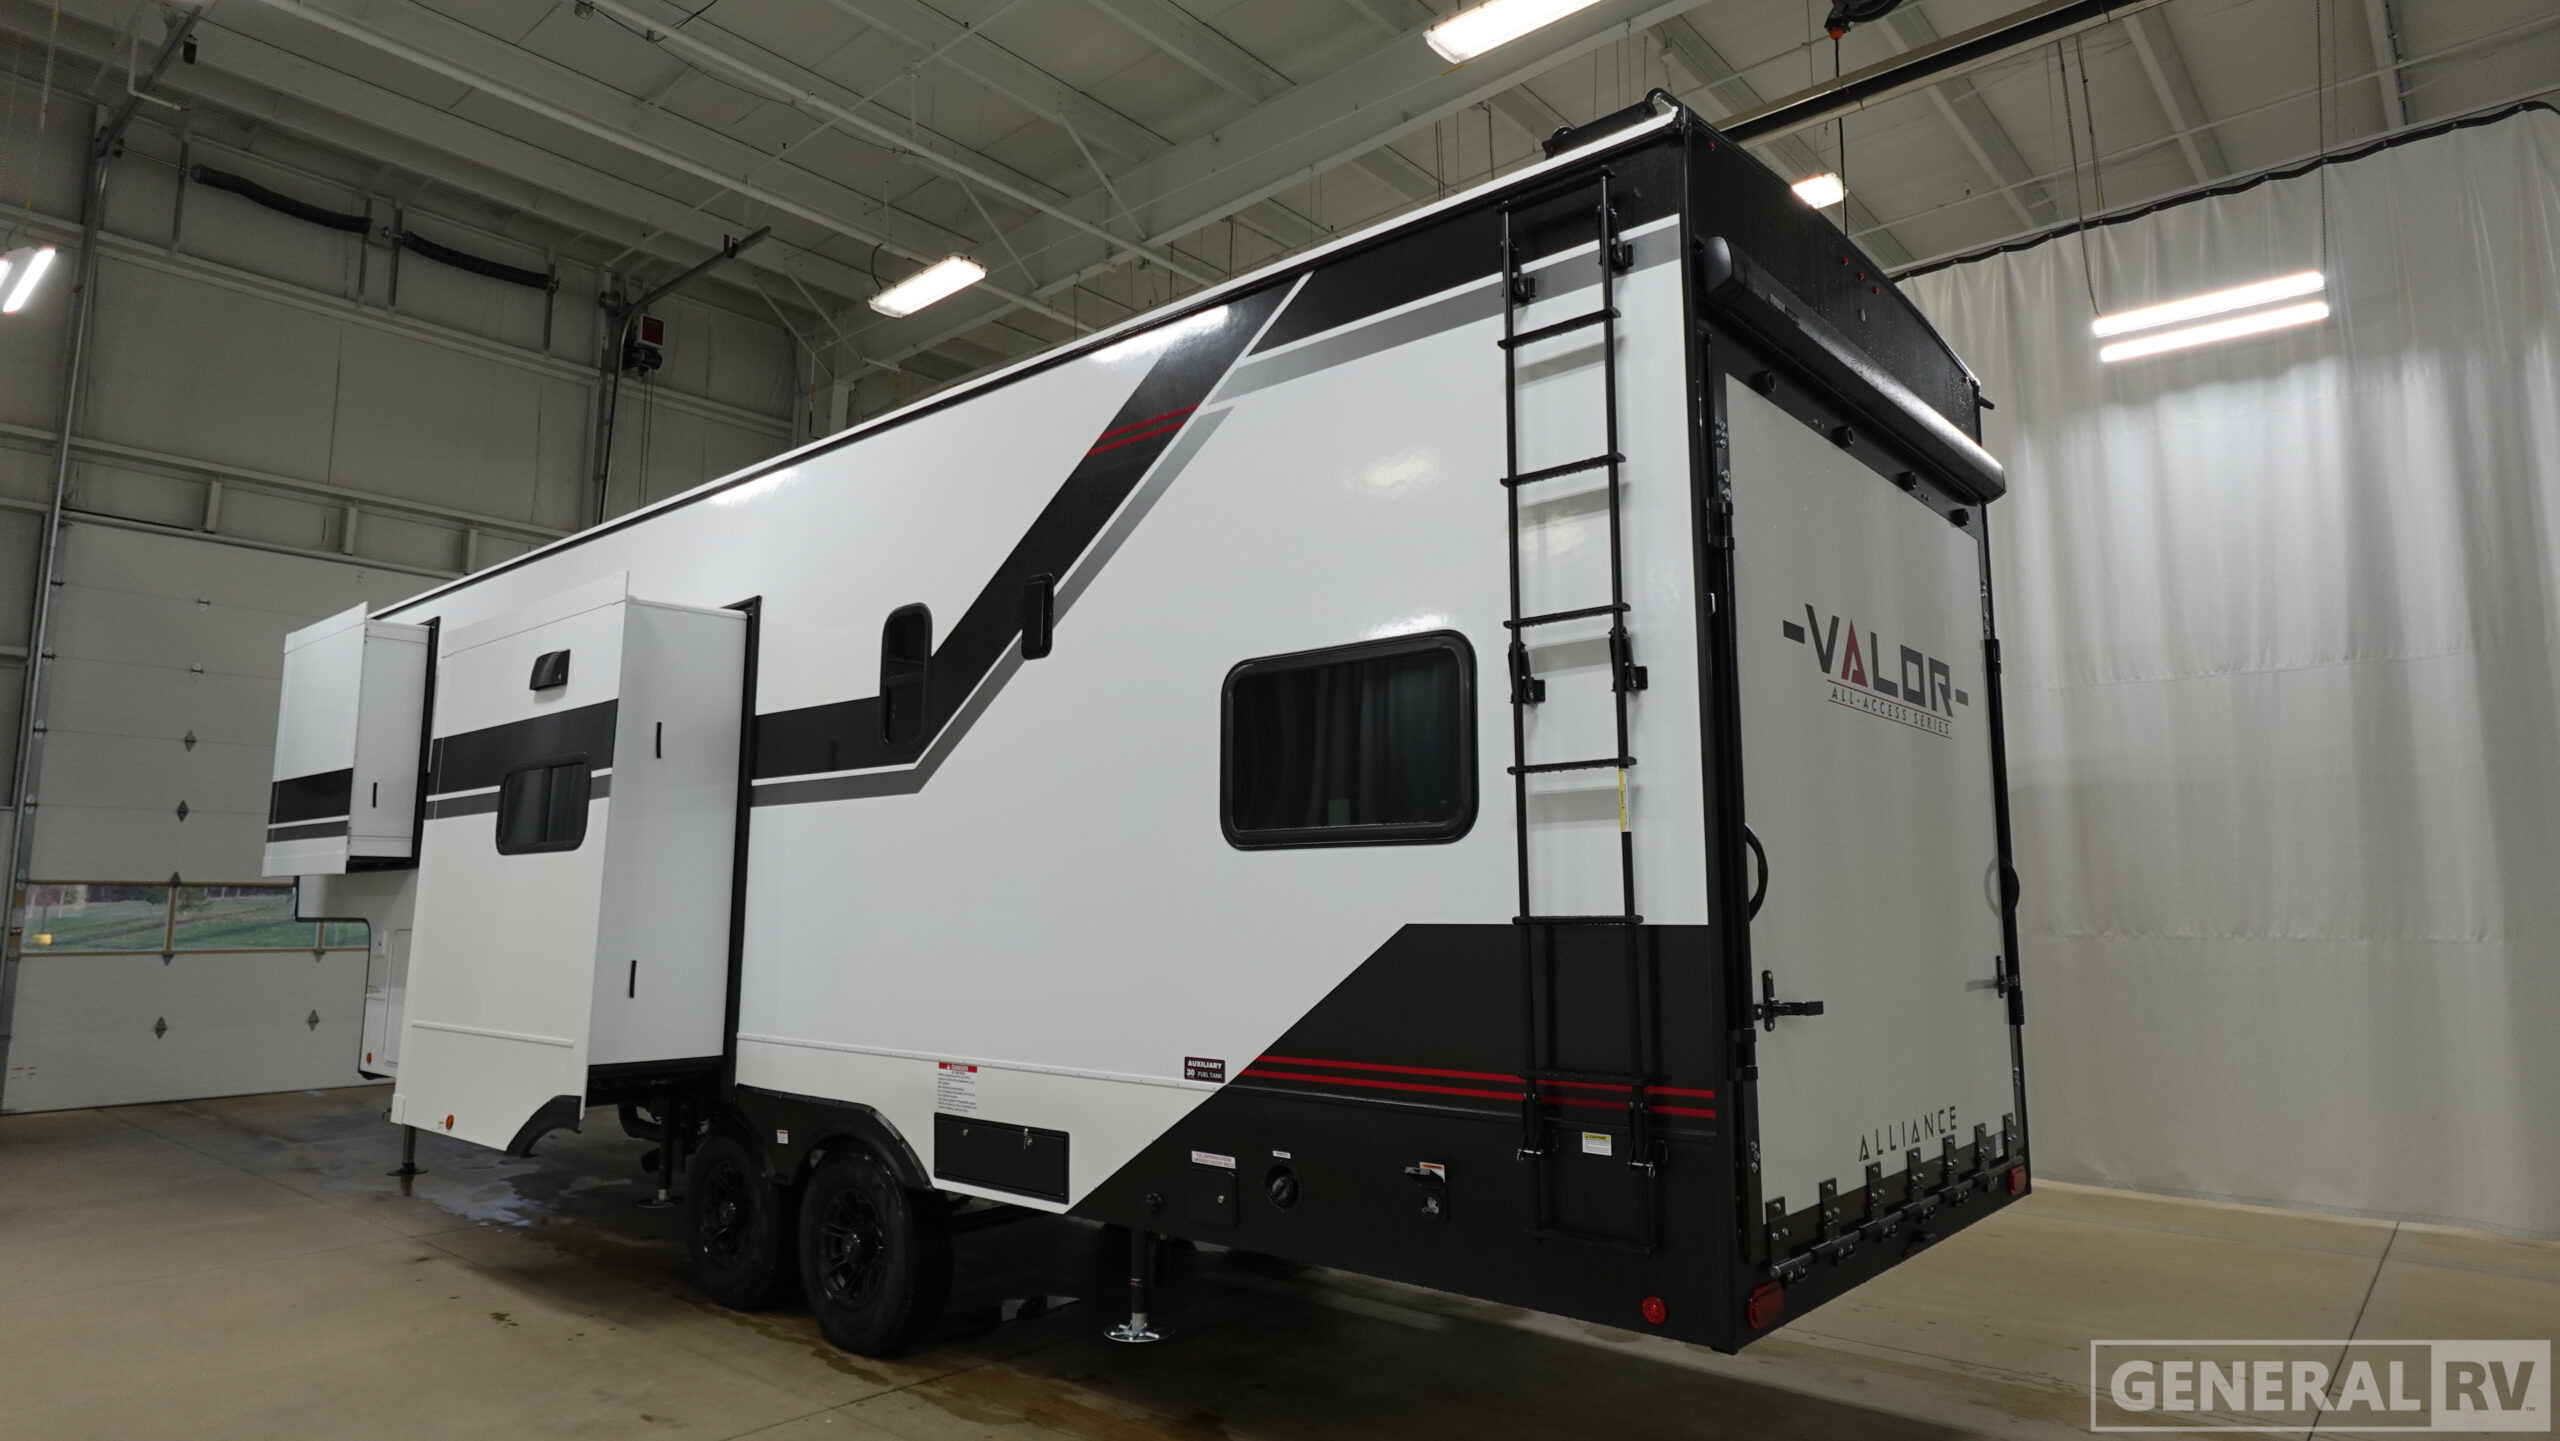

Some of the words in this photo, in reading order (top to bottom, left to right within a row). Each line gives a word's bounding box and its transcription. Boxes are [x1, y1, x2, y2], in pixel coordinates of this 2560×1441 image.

[1804, 603, 1954, 718] VALOR
[1831, 687, 1908, 722] ALL-ACCESS
[1913, 712, 1951, 736] SERIES
[1186, 1068, 1195, 1076] 30
[1187, 1060, 1223, 1070] AUXILIARY
[1859, 1105, 1957, 1162] ALLIANCE
